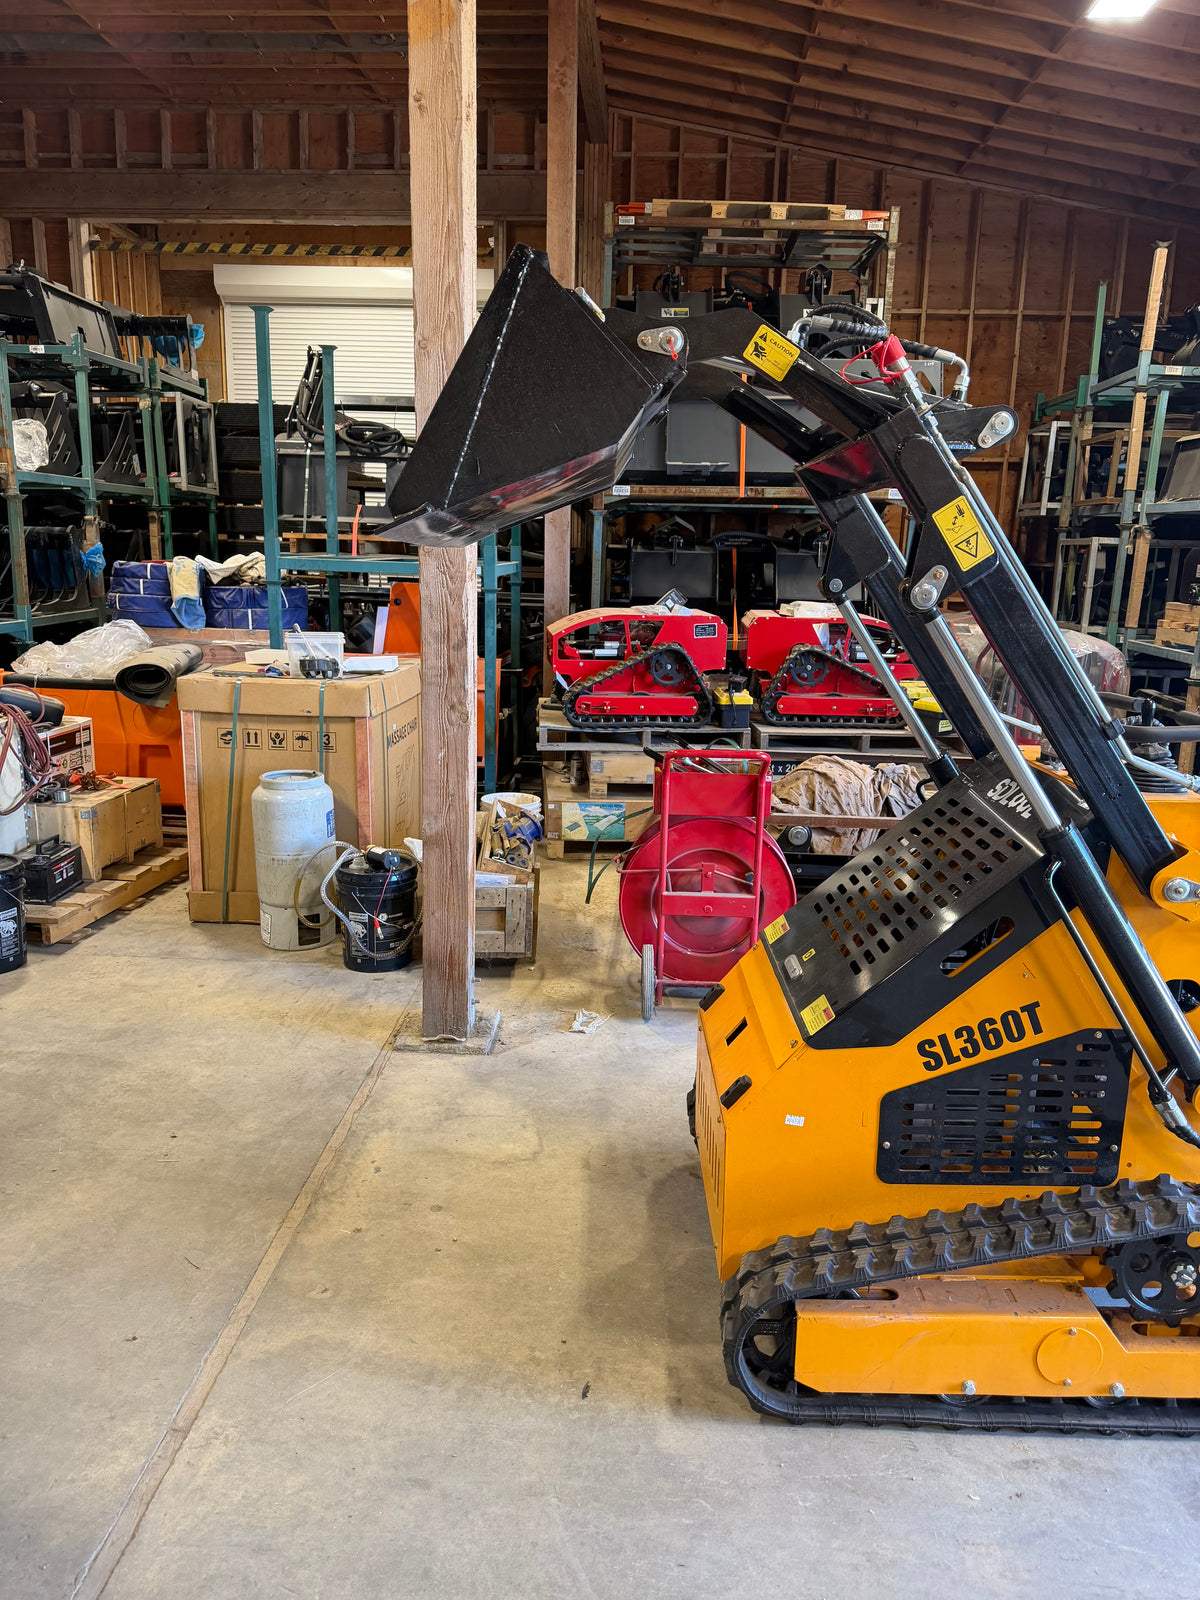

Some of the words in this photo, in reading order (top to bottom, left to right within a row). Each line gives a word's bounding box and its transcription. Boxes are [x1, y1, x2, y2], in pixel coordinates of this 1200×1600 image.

[769, 338, 794, 358] CAUTION
[407, 717, 418, 736] CHAIR
[916, 1000, 1044, 1072] SL360T
